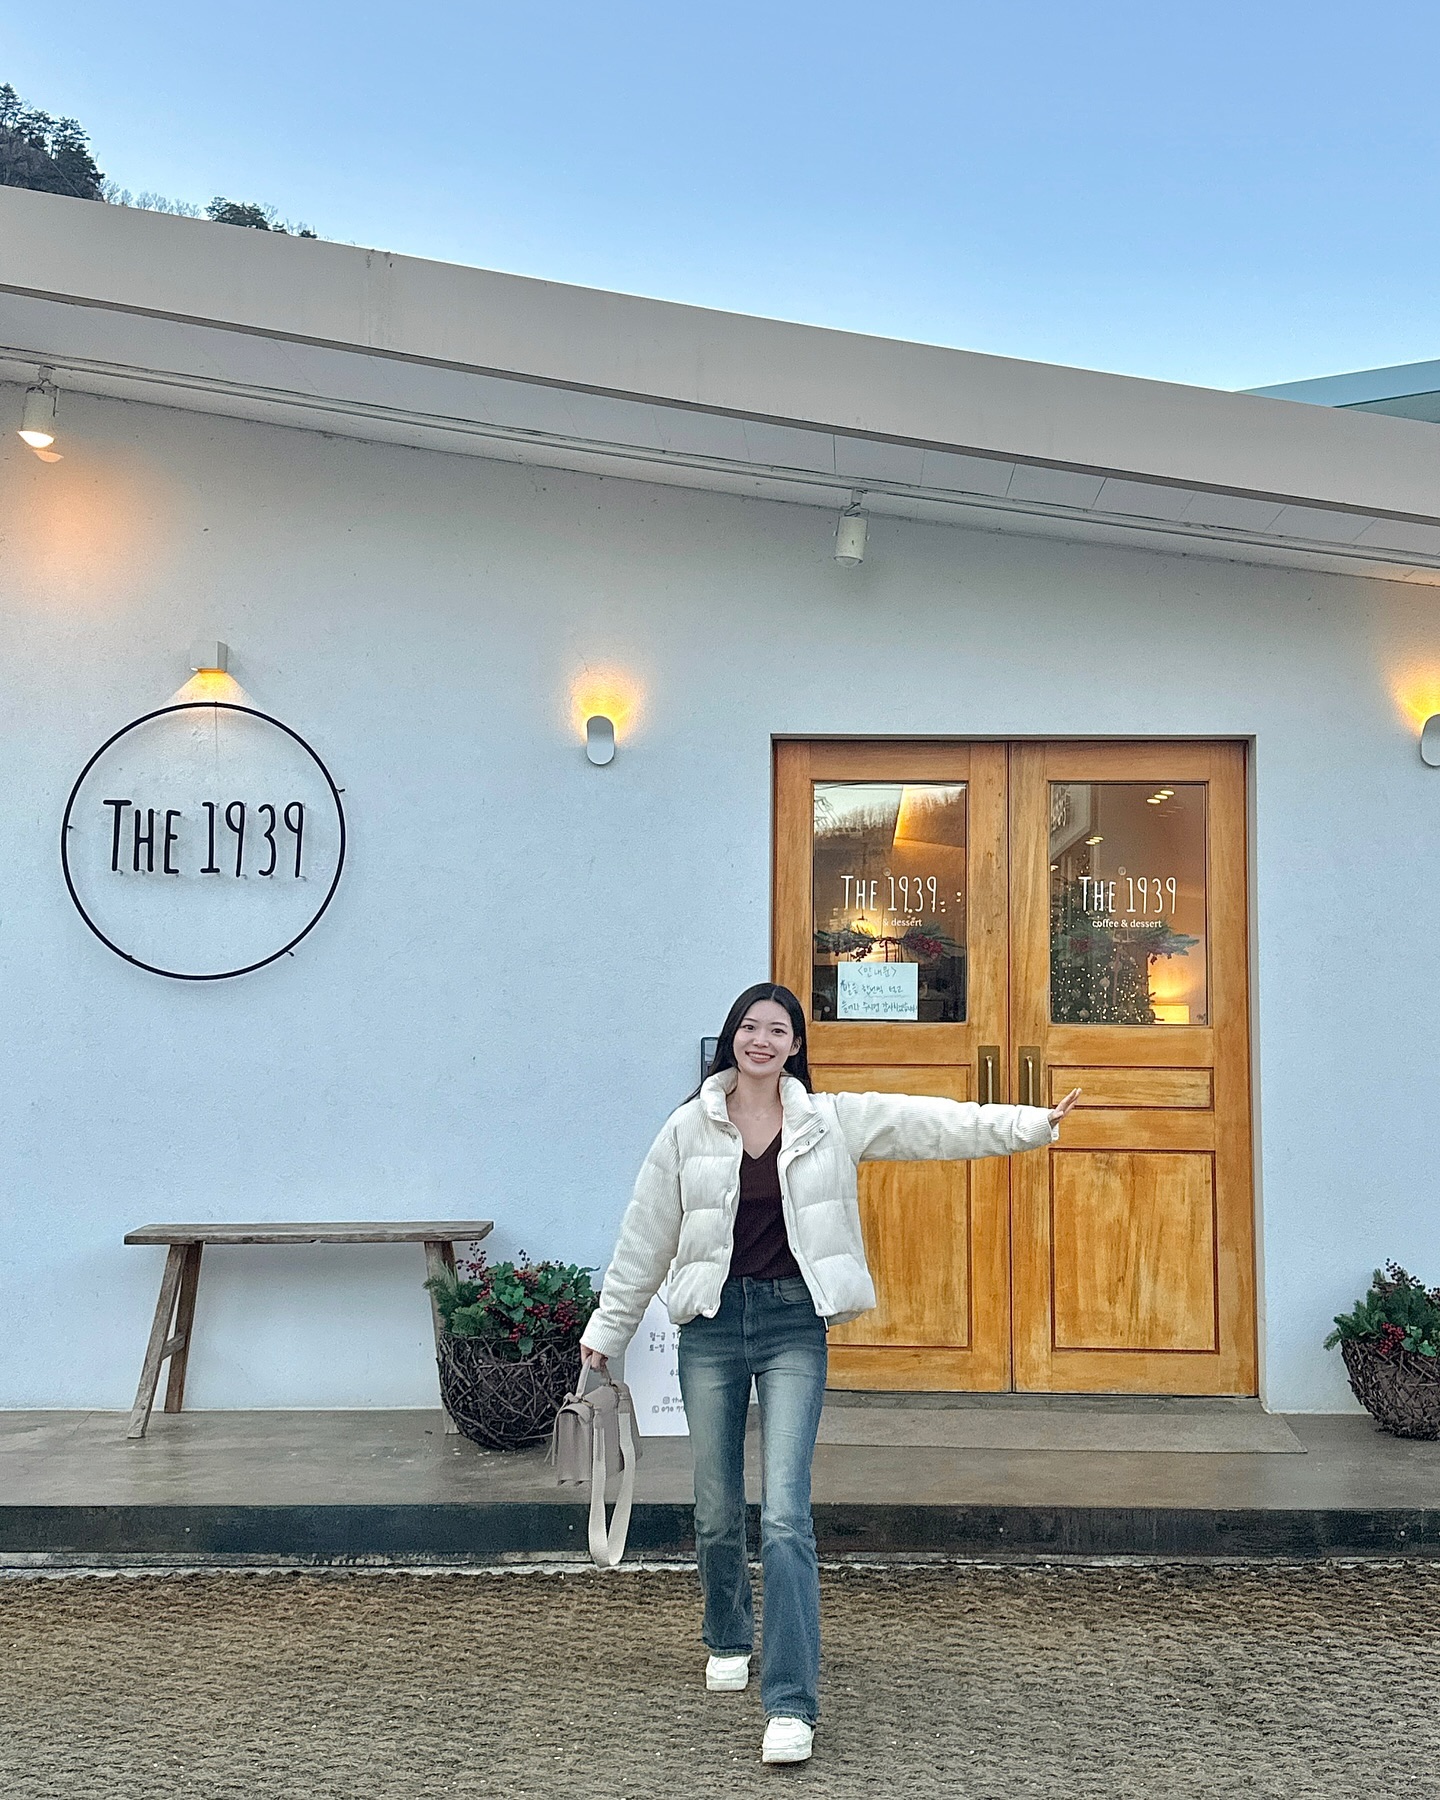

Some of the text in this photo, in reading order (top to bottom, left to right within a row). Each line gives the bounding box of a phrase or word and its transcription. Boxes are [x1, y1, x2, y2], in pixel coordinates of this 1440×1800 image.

[102, 799, 304, 878] THE 1939
[840, 875, 937, 913] THE 1939
[1078, 876, 1177, 914] THE 1939
[891, 918, 923, 927] dessert
[1092, 919, 1162, 928] coffee & dessert
